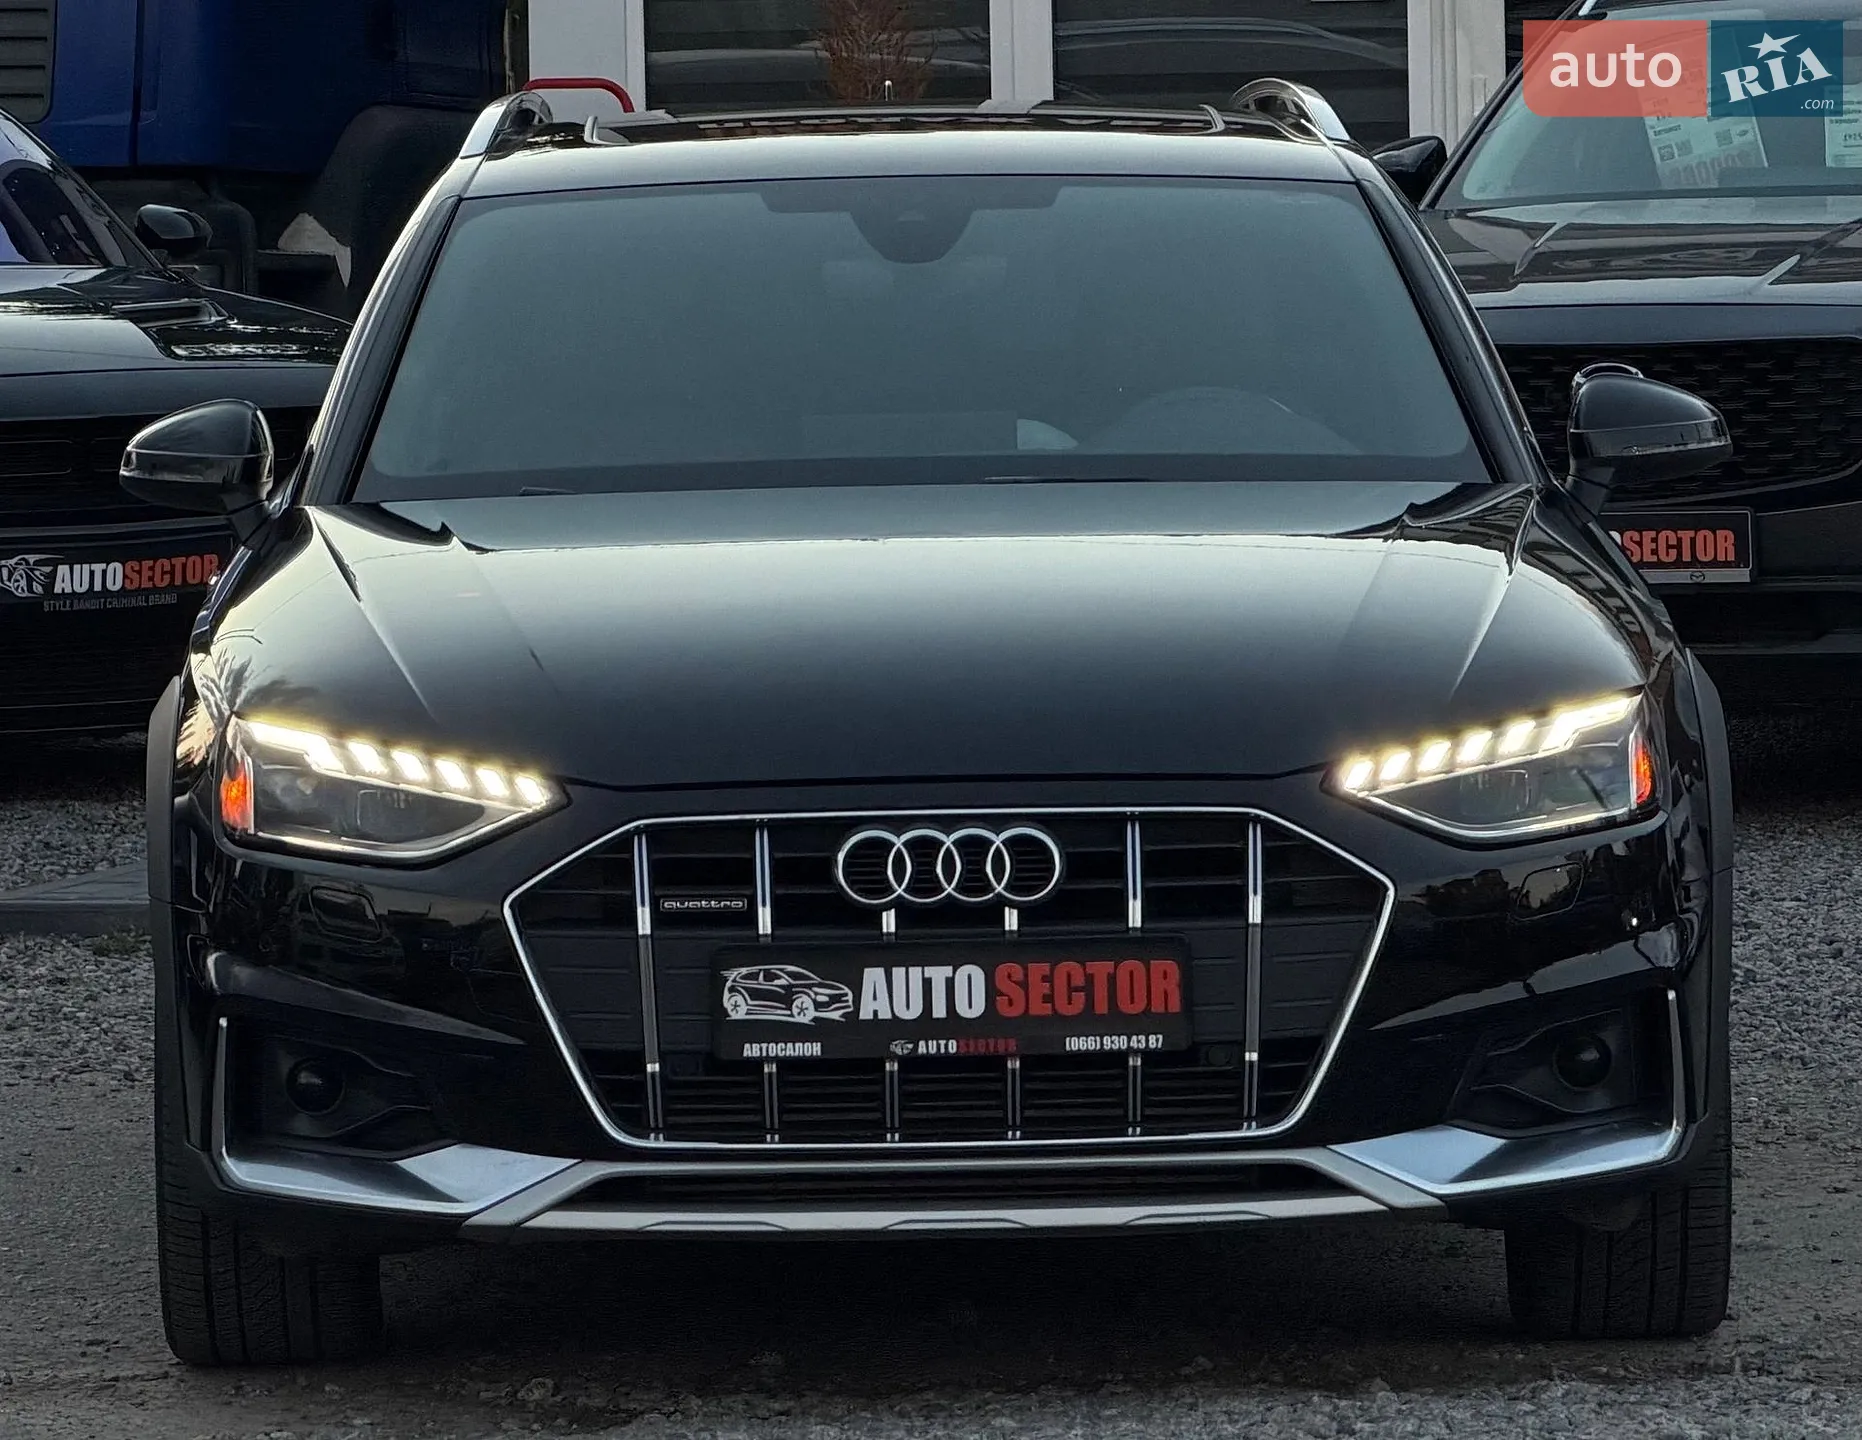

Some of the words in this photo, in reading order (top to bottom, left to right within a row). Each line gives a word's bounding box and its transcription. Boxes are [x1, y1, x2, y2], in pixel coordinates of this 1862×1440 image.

[43, 600, 72, 612] STYLE
[663, 899, 744, 909] quattro
[858, 964, 987, 1020] AUTO
[994, 959, 1182, 1018] SECTOR
[743, 1042, 822, 1058] АВТОСАЛОН
[1065, 1036, 1101, 1051] (066)
[1103, 1035, 1128, 1050] 930
[1129, 1034, 1146, 1049] 43
[1148, 1034, 1163, 1049] 87
